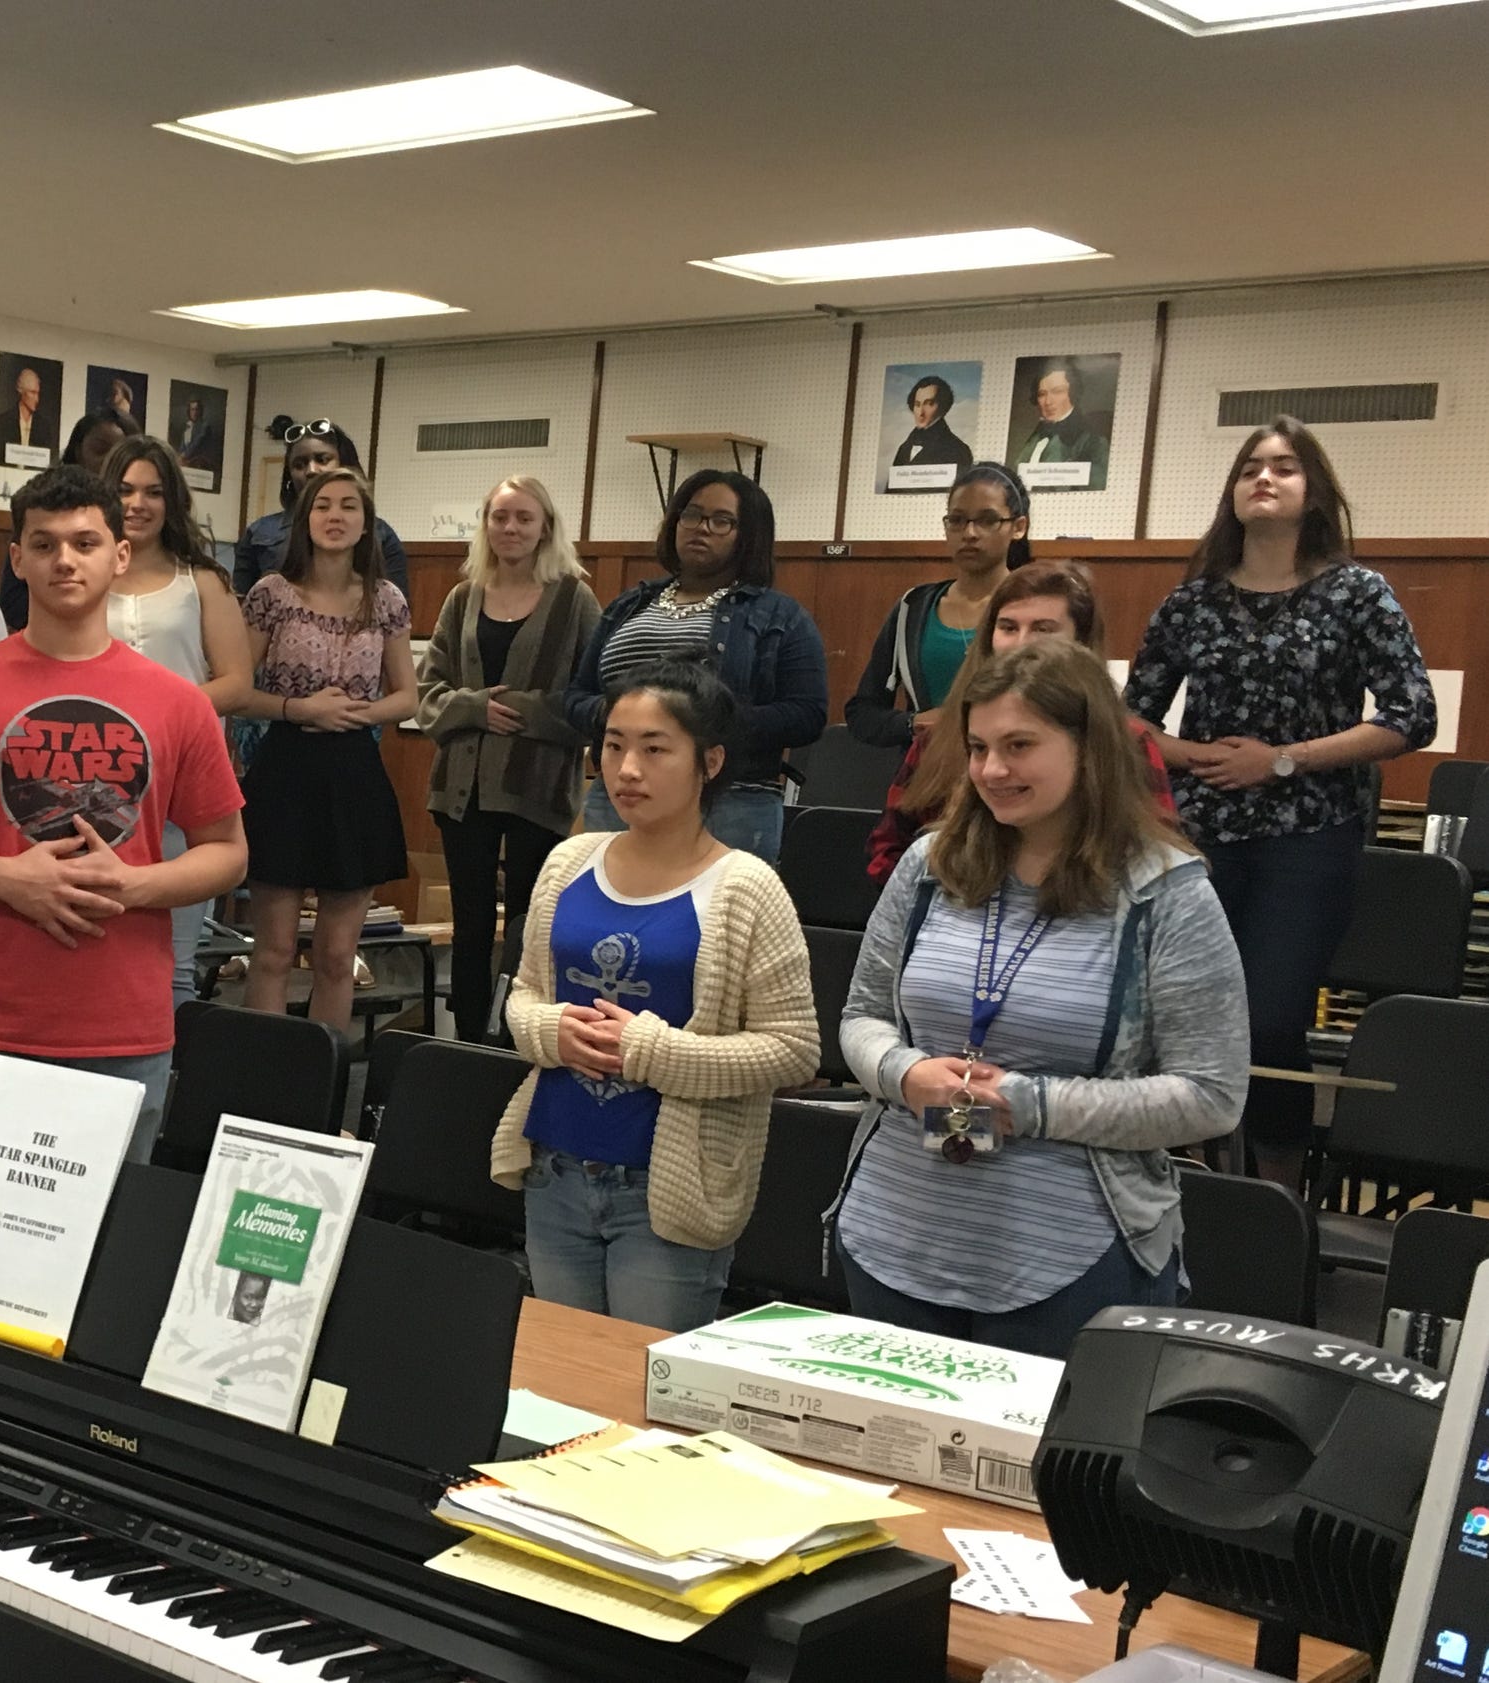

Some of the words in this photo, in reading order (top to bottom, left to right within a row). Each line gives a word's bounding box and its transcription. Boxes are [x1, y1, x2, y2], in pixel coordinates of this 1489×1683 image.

[7, 719, 144, 754] STAR
[8, 748, 143, 783] WARS
[977, 943, 995, 989] HUSKIES
[996, 952, 1026, 991] RONALD
[1021, 919, 1047, 950] REAGA
[32, 1131, 58, 1149] THE
[23, 1151, 87, 1177] SPANGLED
[6, 1168, 57, 1193] BANNER
[233, 1209, 308, 1243] Memories
[254, 1202, 299, 1225] Wanting
[1122, 1316, 1286, 1344] MUSIC
[780, 1360, 940, 1402] Crayola
[1313, 1344, 1446, 1400] RRHS
[738, 1382, 779, 1403] C5E25
[790, 1393, 823, 1413] 1712
[90, 1424, 138, 1453] Roland
